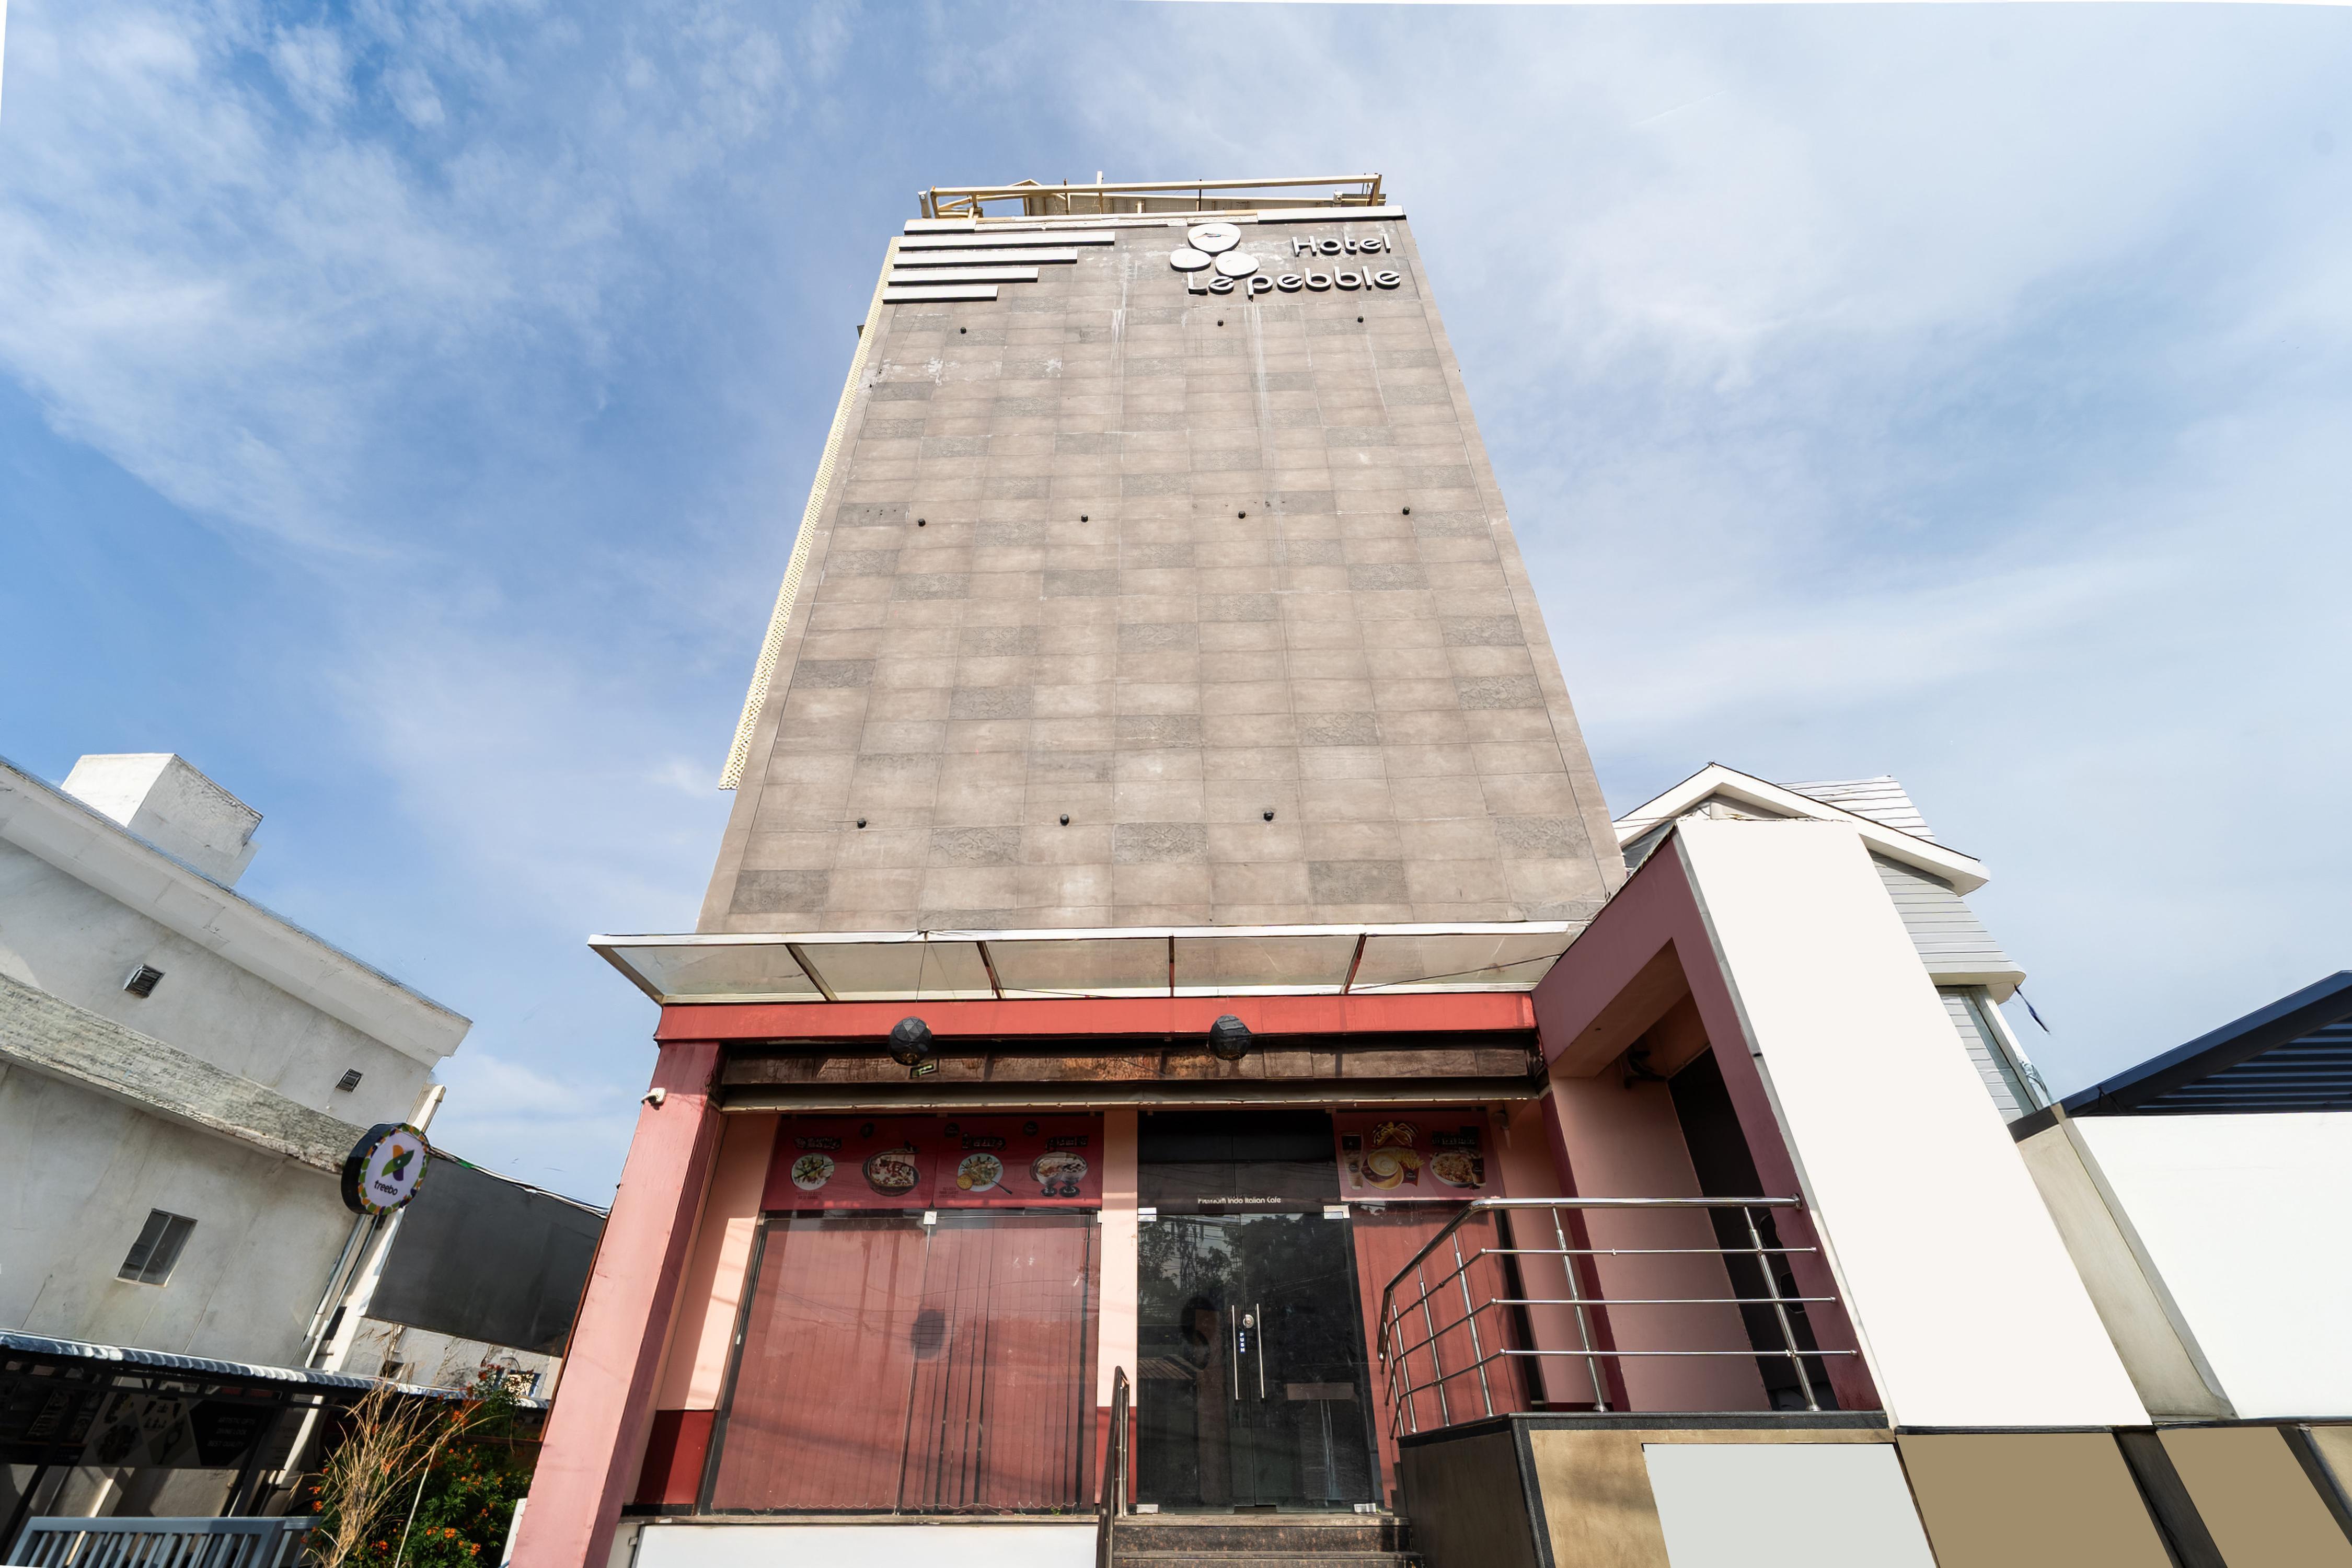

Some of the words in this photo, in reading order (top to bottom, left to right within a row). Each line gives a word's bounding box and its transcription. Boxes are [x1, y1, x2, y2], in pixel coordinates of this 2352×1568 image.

[1292, 233, 1391, 257] Hotel
[1186, 272, 1235, 296] Le
[1247, 266, 1401, 300] pebble
[374, 1180, 398, 1196] treebo
